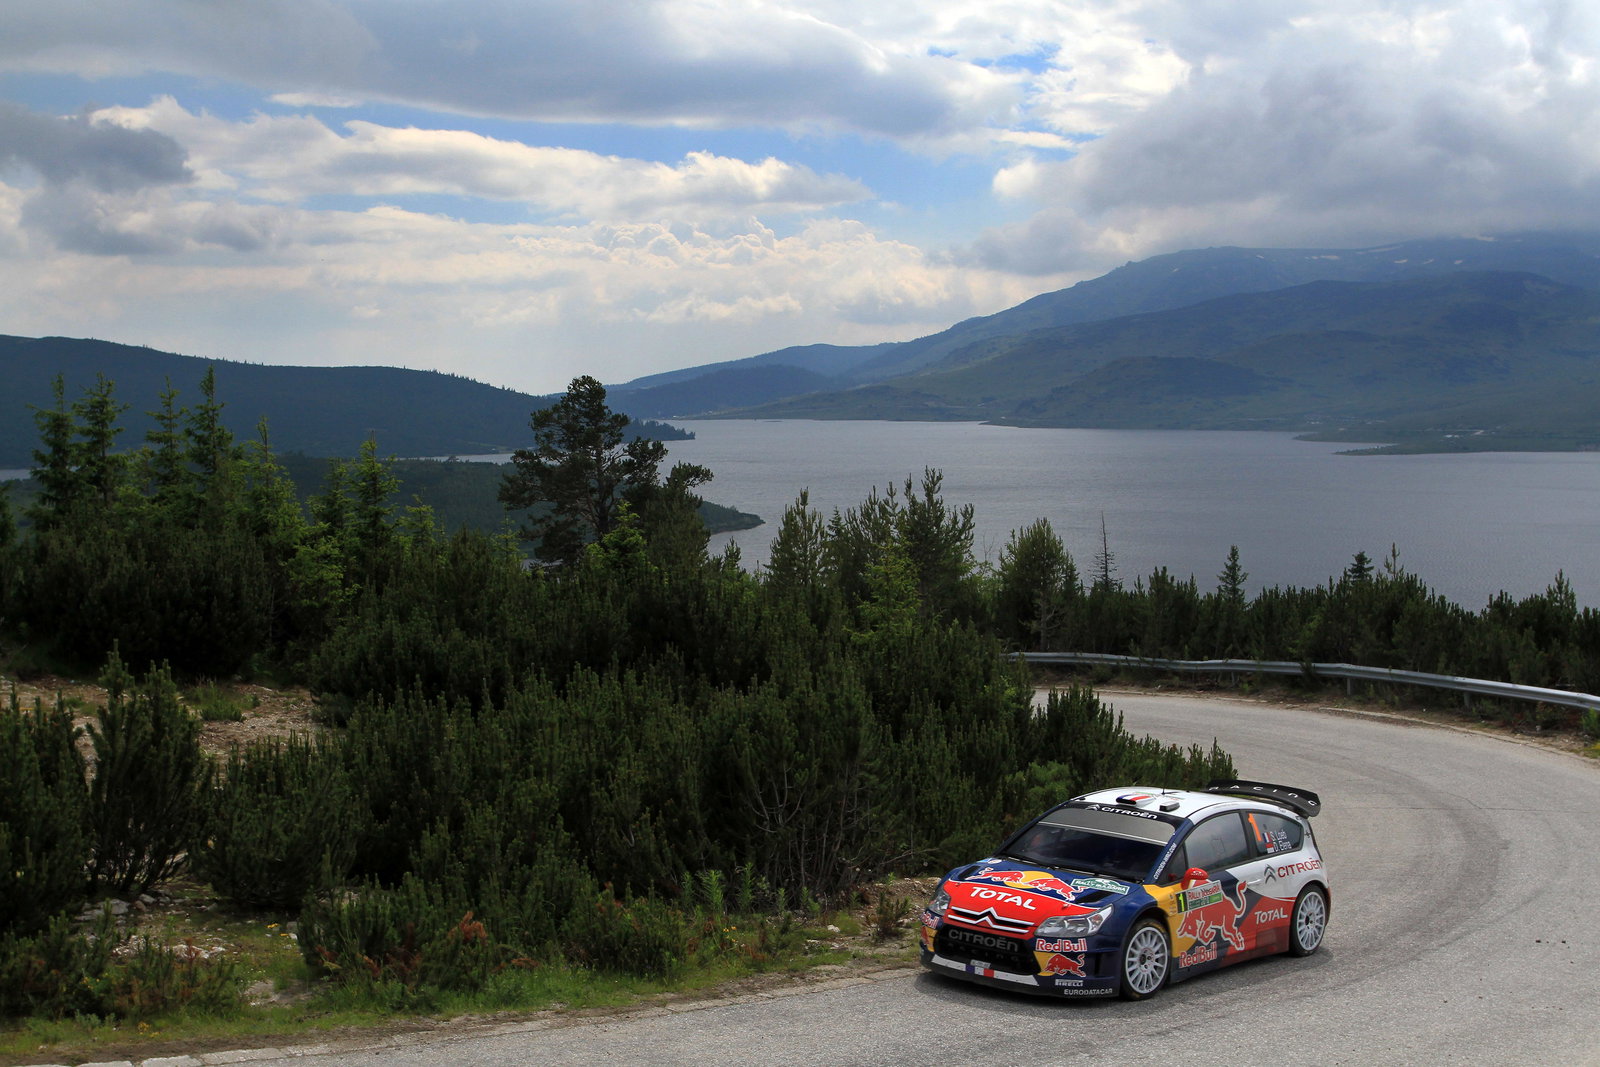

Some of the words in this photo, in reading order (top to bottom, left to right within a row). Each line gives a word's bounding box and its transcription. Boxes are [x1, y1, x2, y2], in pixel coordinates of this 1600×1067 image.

[1247, 812, 1262, 841] 1
[1276, 828, 1288, 841] Loeb
[1279, 840, 1292, 851] Elena
[970, 886, 1036, 911] TOTAL
[1178, 893, 1185, 912] 1
[1254, 907, 1288, 925] TOTAL
[1036, 938, 1061, 952] Red
[1062, 938, 1087, 952] Bull
[1179, 946, 1201, 968] Red
[1199, 941, 1218, 964] Bull
[1055, 979, 1083, 987] PIRELLI
[1063, 988, 1113, 996] EURODATACAR
